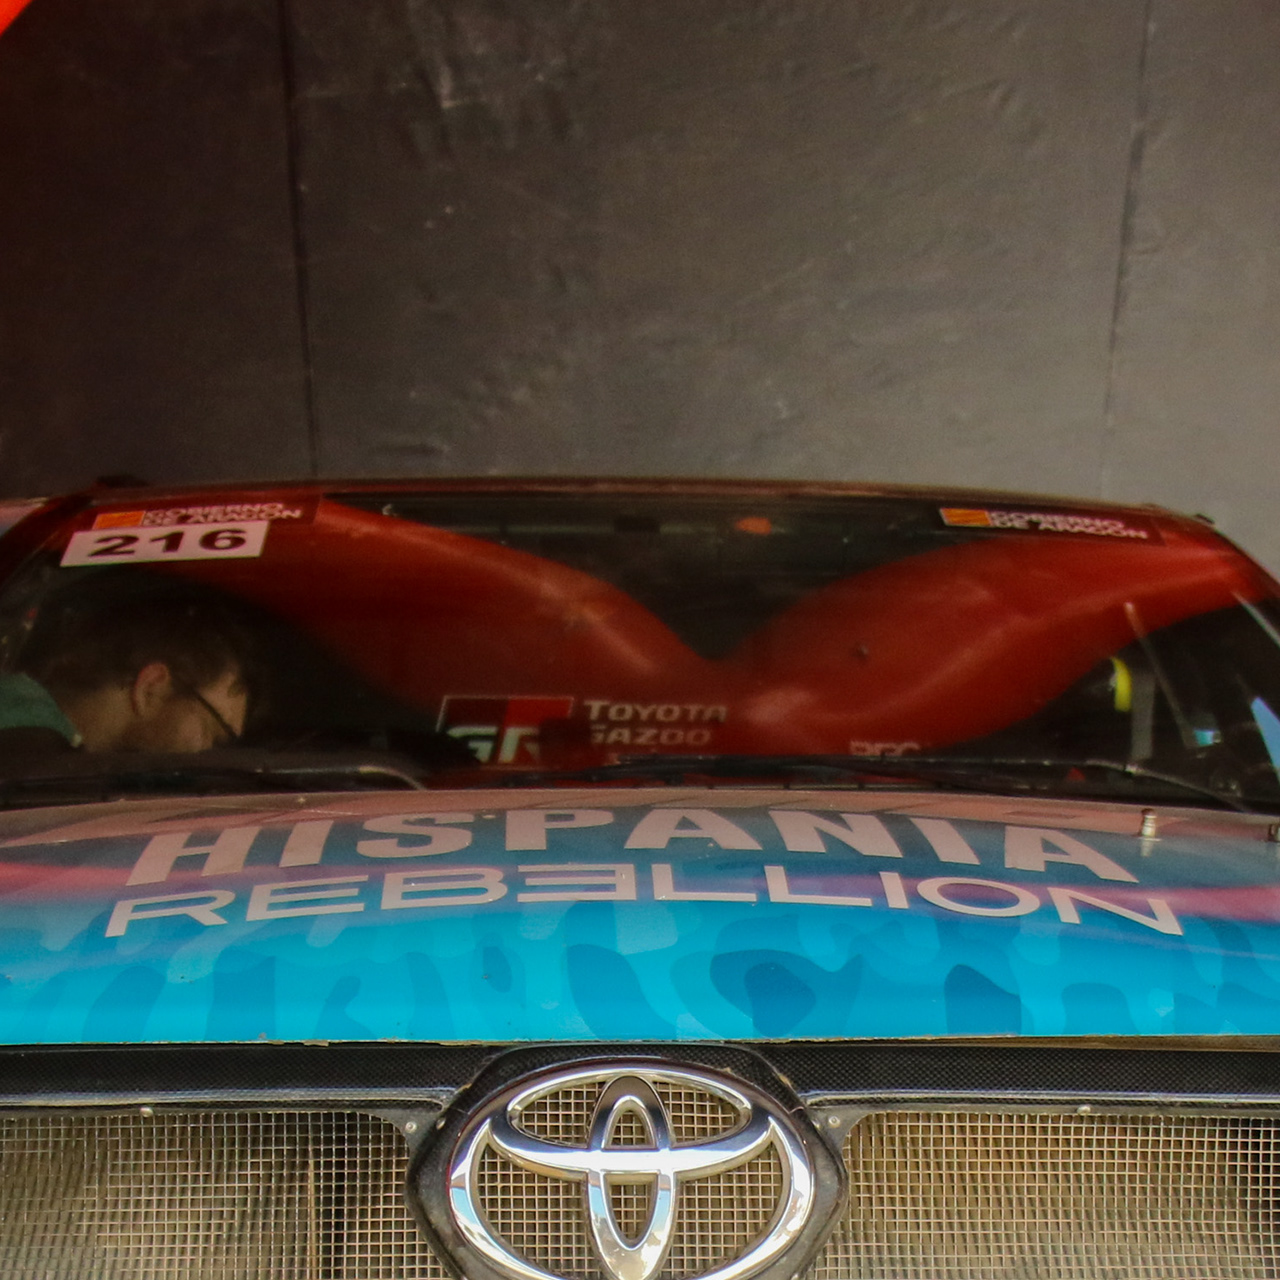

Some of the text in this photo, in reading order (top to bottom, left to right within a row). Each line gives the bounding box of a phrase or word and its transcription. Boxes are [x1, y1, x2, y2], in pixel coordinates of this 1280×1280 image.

[87, 528, 247, 558] 216
[583, 699, 728, 723] TOYOTA
[124, 807, 1140, 887] HISPANIA
